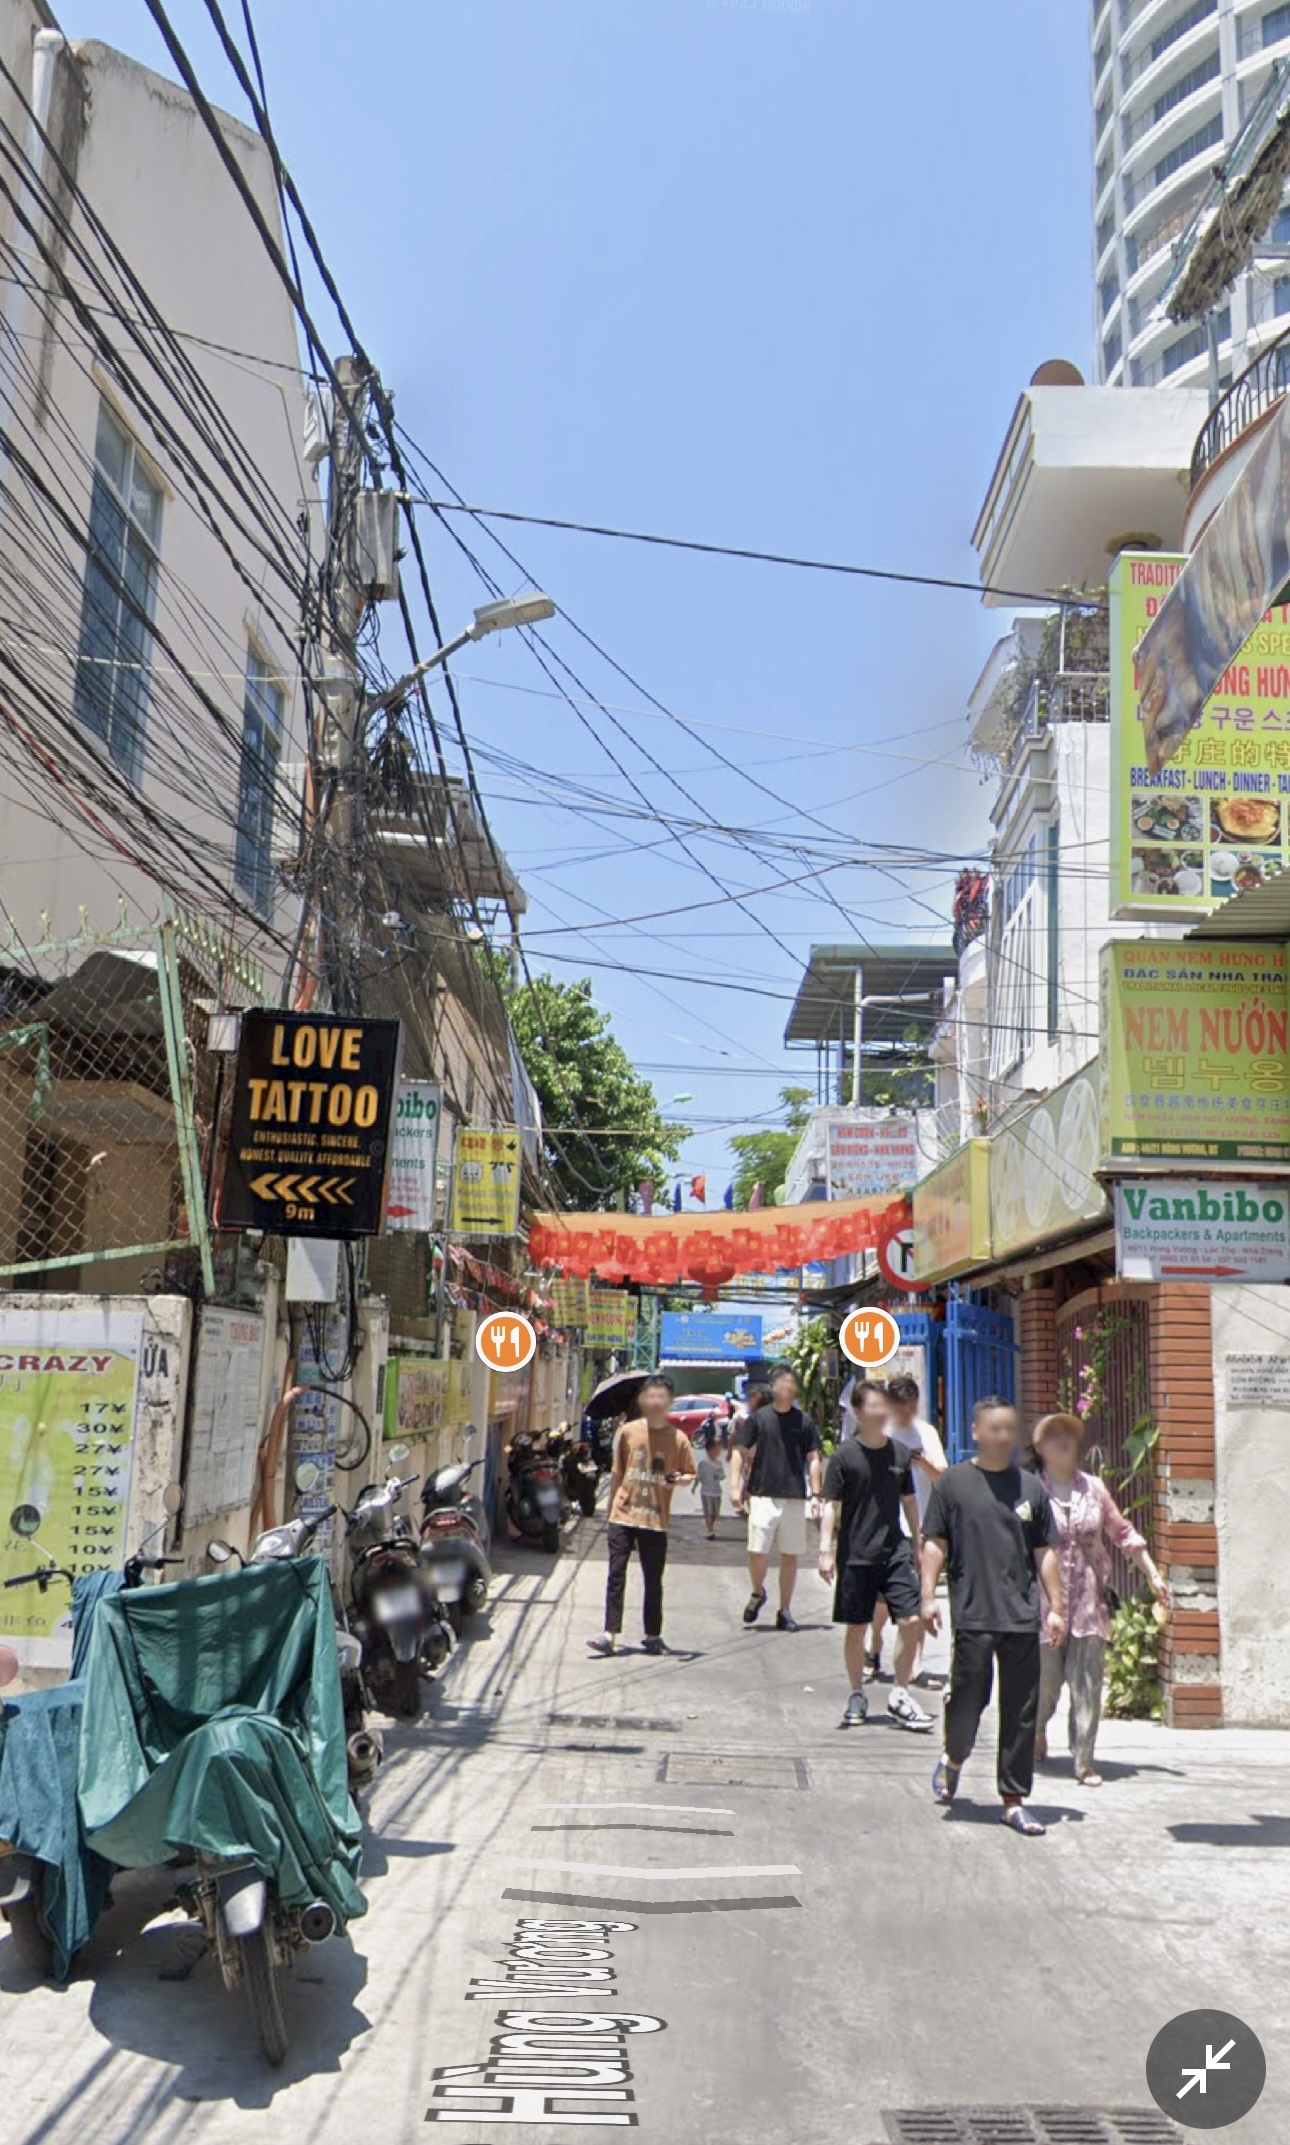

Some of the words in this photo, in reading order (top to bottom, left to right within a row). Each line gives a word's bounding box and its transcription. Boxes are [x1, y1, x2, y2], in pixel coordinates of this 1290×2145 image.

[1193, 770, 1226, 790] LUNCH
[1233, 772, 1270, 792] DINNER
[1177, 951, 1212, 965] NEM
[1209, 971, 1245, 981] NHA
[1124, 1006, 1190, 1052] NEM
[272, 1024, 363, 1071] LOVE
[248, 1079, 379, 1128] TATTOO
[285, 1204, 314, 1220] 9m
[1123, 1188, 1284, 1222] Vanbibo
[1123, 1226, 1200, 1241] Backpackers
[1216, 1229, 1286, 1242] Apartments
[0, 1355, 113, 1372] CRAZY
[76, 1422, 125, 1434] 30¥
[75, 1443, 122, 1454] 27¥
[73, 1465, 120, 1476] 27¥
[74, 1486, 119, 1497] 15¥
[72, 1505, 117, 1516] 15¥
[70, 1525, 115, 1536] 15¥
[69, 1544, 114, 1555] 10¥
